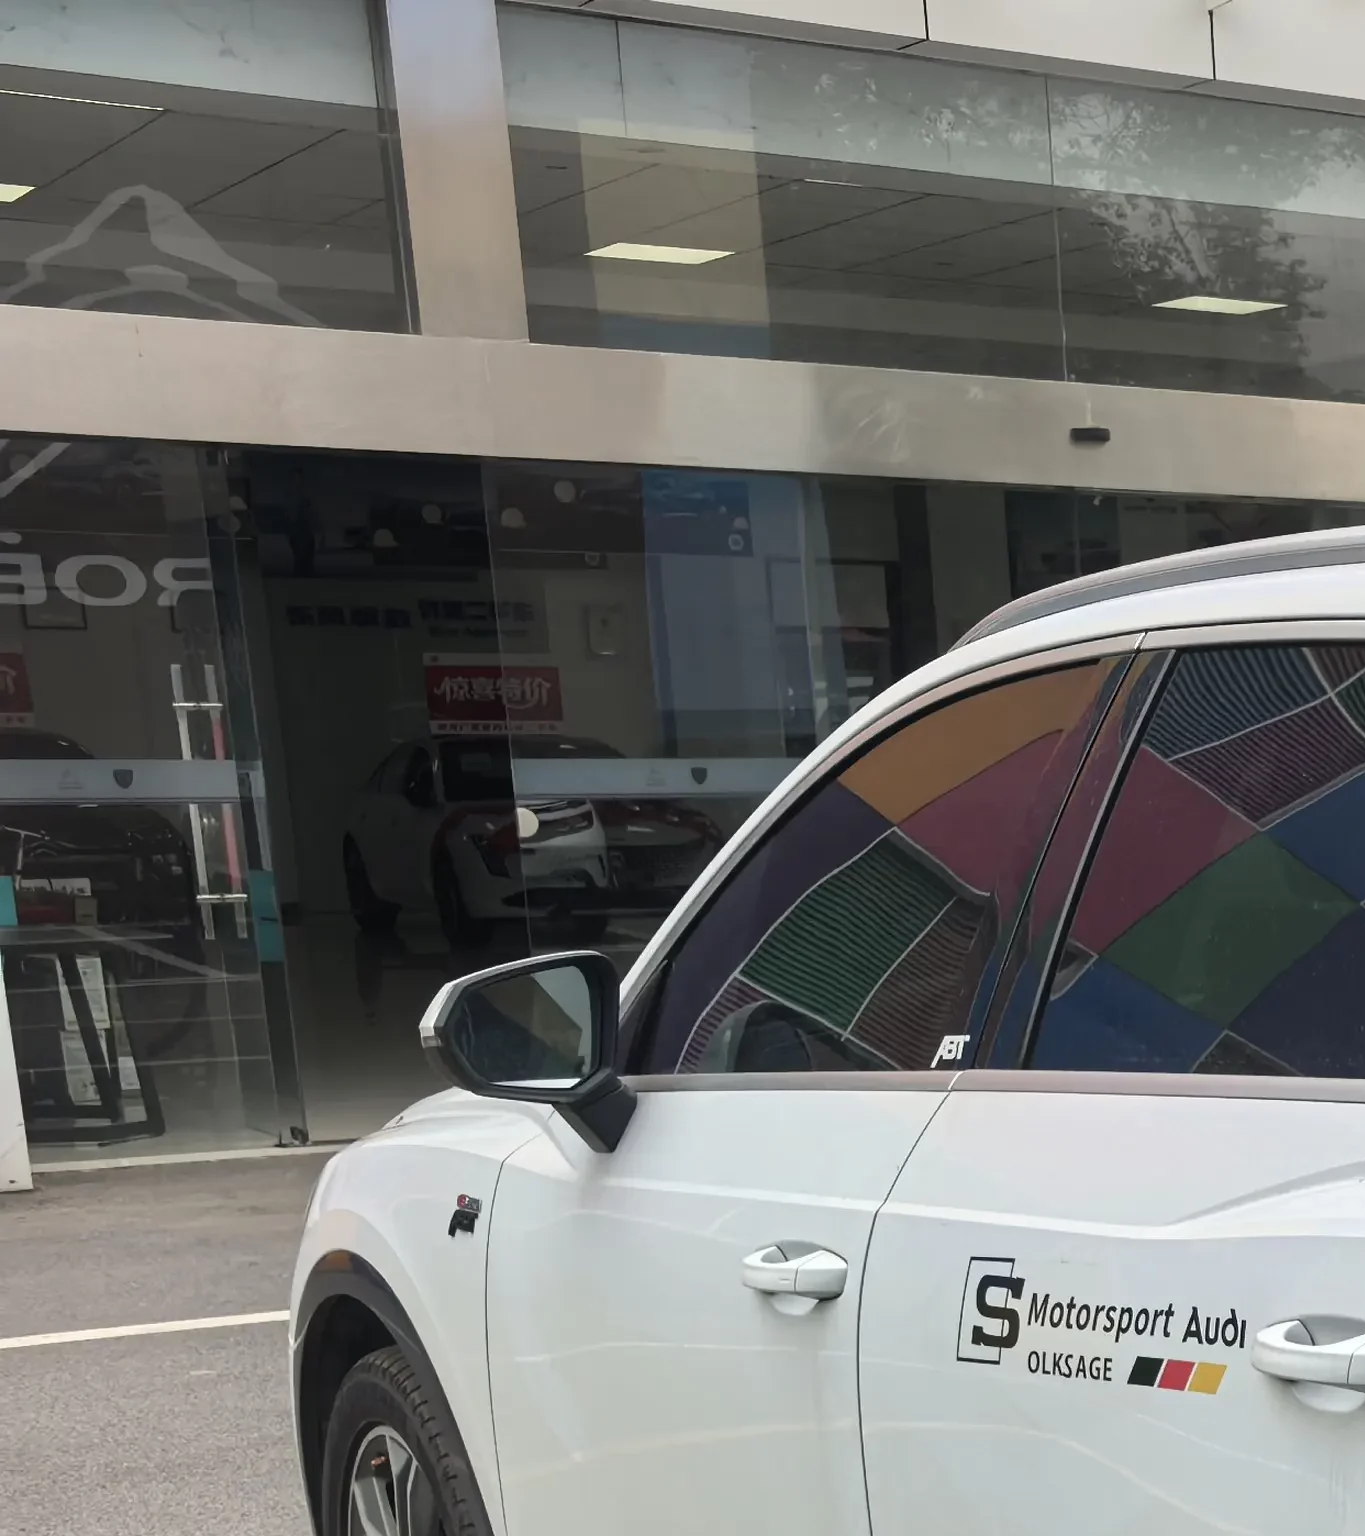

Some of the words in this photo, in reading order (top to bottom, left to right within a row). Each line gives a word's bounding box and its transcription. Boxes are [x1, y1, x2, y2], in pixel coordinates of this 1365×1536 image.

[433, 674, 553, 710] 惊喜特价
[930, 1034, 971, 1069] ABT
[971, 1274, 1026, 1349] S
[1027, 1293, 1175, 1343] Motorsport
[1028, 1351, 1113, 1382] OLKSAGE
